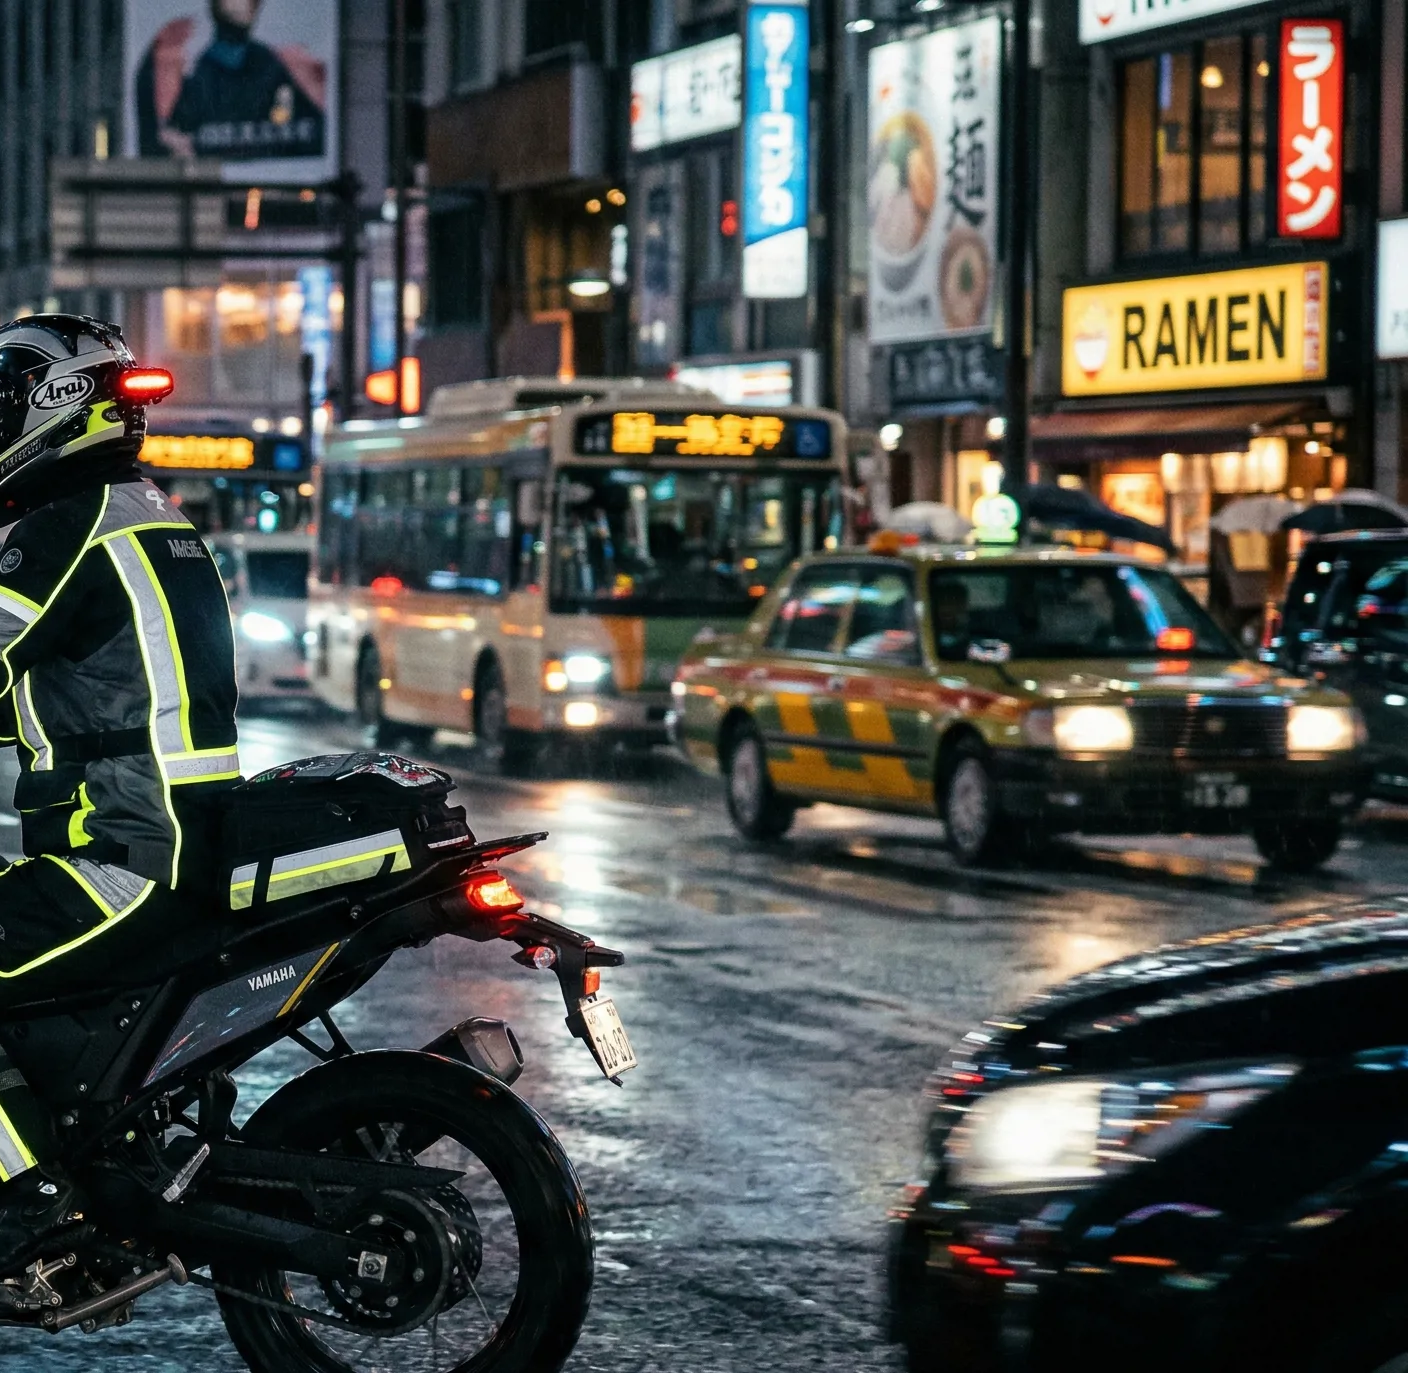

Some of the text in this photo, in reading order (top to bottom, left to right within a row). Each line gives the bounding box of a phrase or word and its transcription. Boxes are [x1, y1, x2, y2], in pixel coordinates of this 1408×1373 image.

[1286, 26, 1336, 232] ラーメン
[1123, 290, 1287, 370] RAMEN
[35, 376, 85, 407] Arai
[247, 964, 297, 991] YAMAHA
